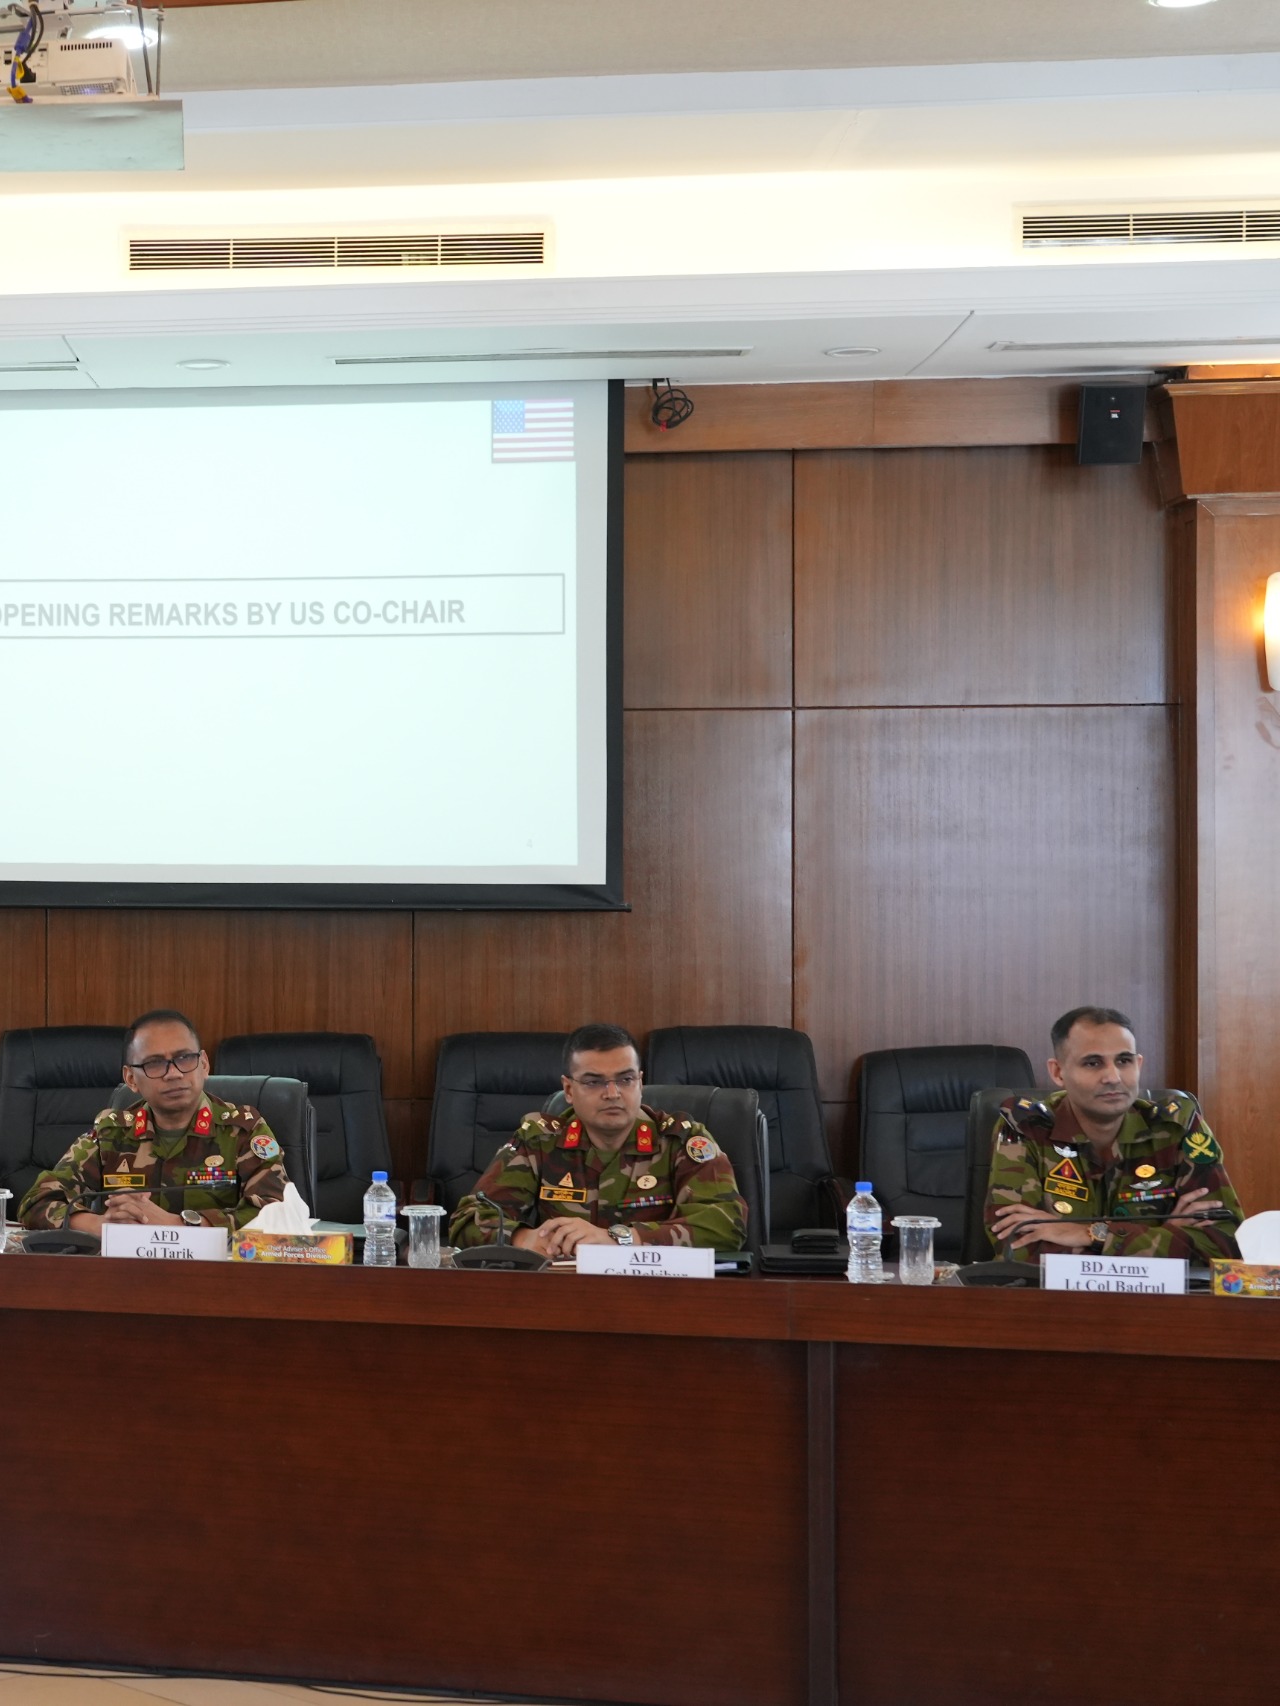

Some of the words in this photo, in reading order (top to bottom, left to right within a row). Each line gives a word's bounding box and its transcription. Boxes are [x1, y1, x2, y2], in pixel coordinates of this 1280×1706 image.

[109, 601, 239, 627] REMARKS
[247, 601, 283, 626] BY
[290, 600, 325, 626] US
[333, 599, 466, 625] CO-CHAIR
[150, 1230, 179, 1241] AFD
[135, 1246, 157, 1258] Col
[161, 1247, 195, 1259] Tarik
[283, 1251, 305, 1259] Forces
[630, 1251, 661, 1262] AFD
[1080, 1260, 1103, 1273] BD
[1085, 1279, 1111, 1291] Col
[1116, 1280, 1166, 1293] Badrul
